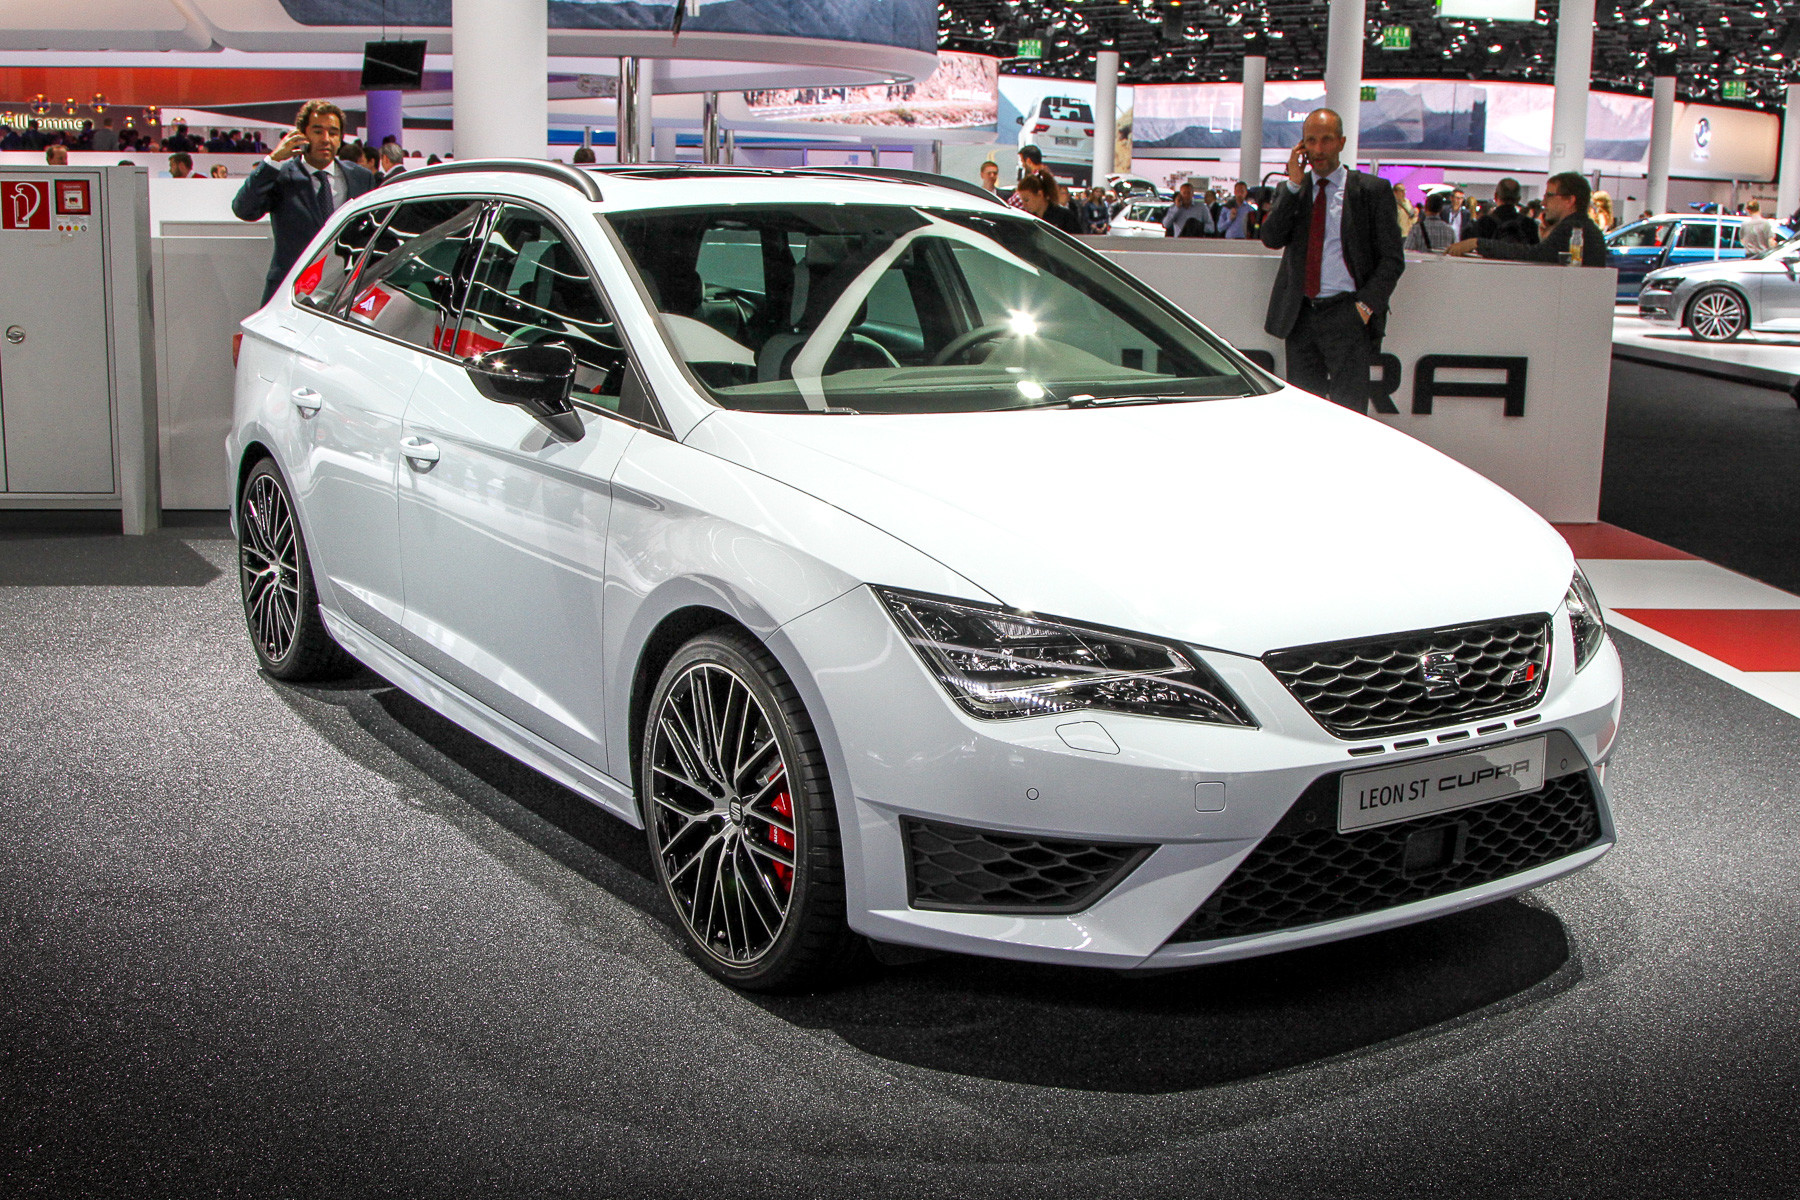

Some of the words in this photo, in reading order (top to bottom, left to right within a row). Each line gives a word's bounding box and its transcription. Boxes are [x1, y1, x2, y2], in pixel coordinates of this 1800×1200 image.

[1360, 783, 1404, 810] LEON
[1409, 779, 1430, 801] ST
[1438, 759, 1530, 792] CUPRA
